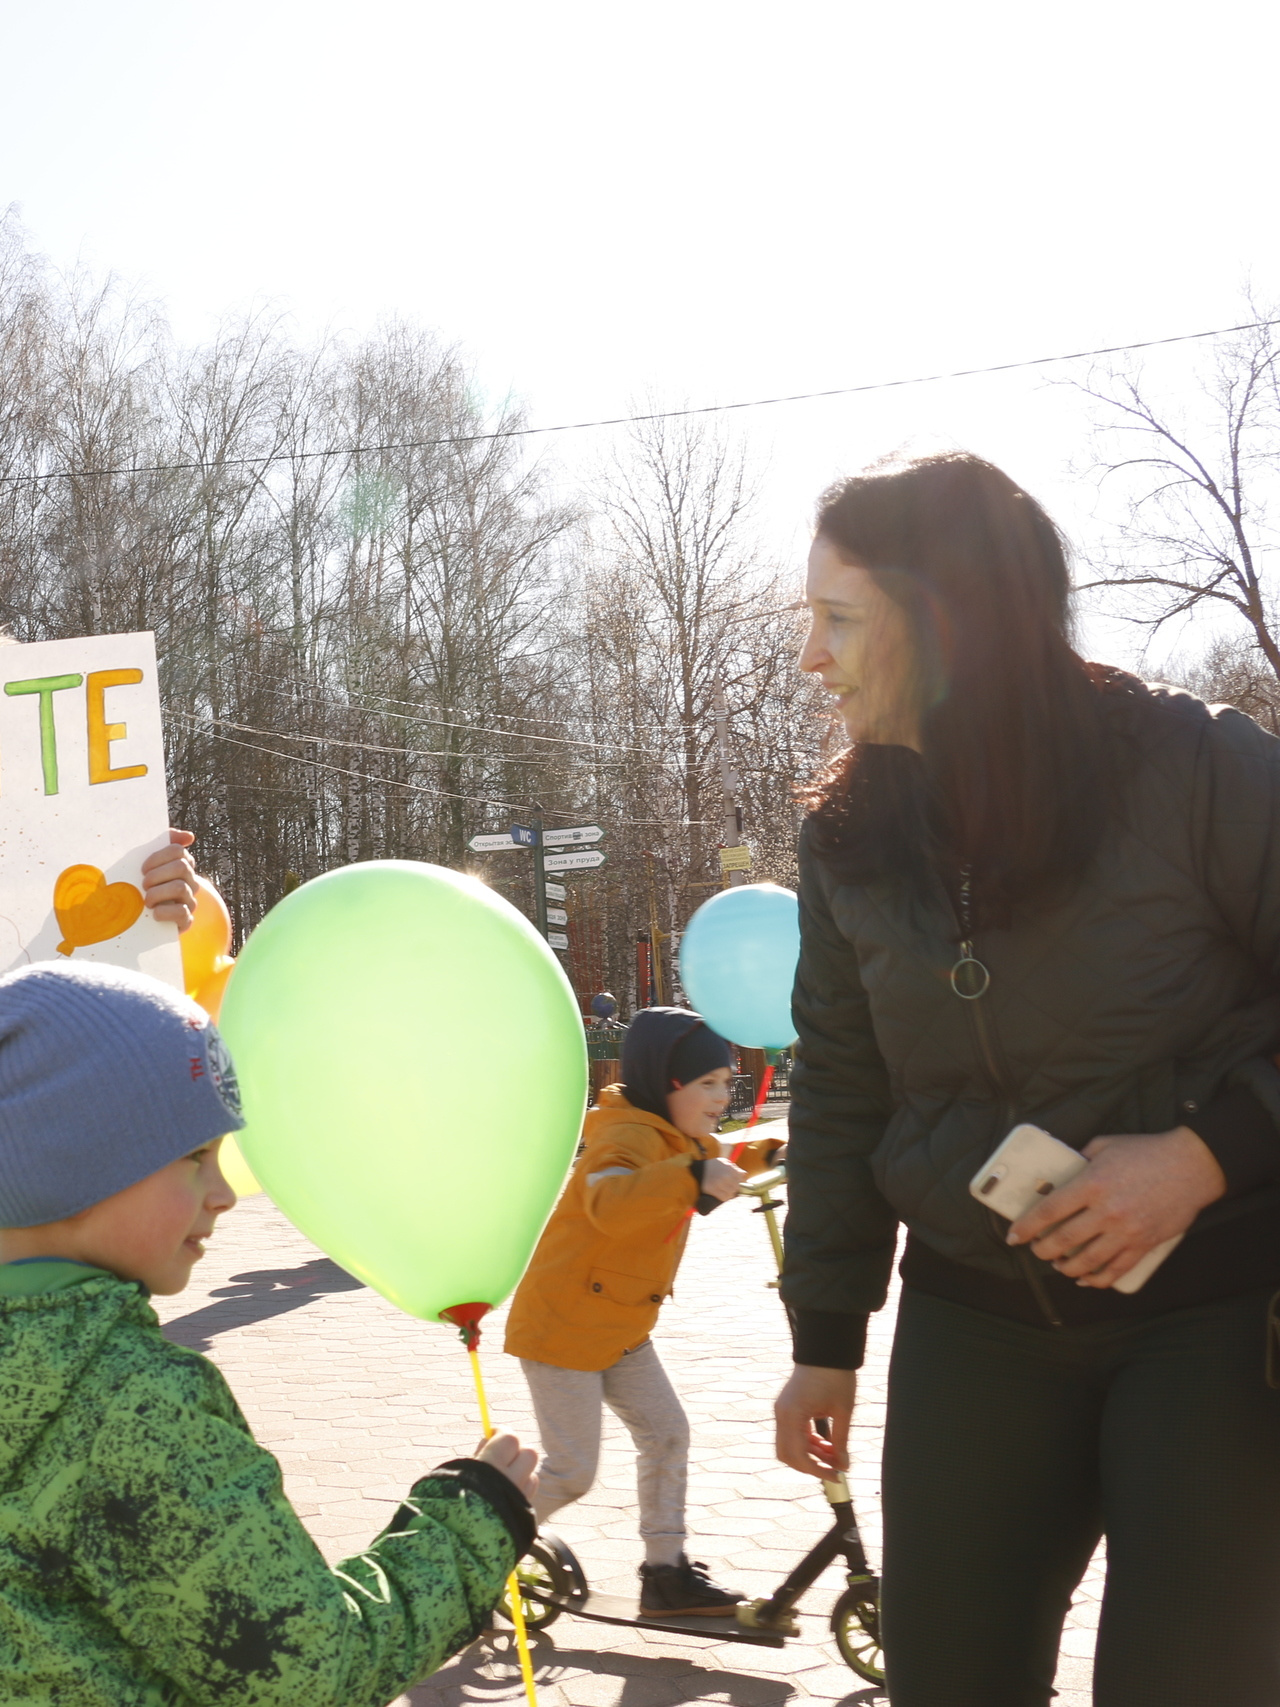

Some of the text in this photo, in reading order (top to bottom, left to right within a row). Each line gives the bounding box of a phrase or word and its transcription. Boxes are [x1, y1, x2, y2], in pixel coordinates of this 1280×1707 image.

[519, 829, 532, 843] WC
[545, 833, 583, 841] Спортивя
[474, 840, 504, 848] Открытая
[576, 856, 600, 864] пруда
